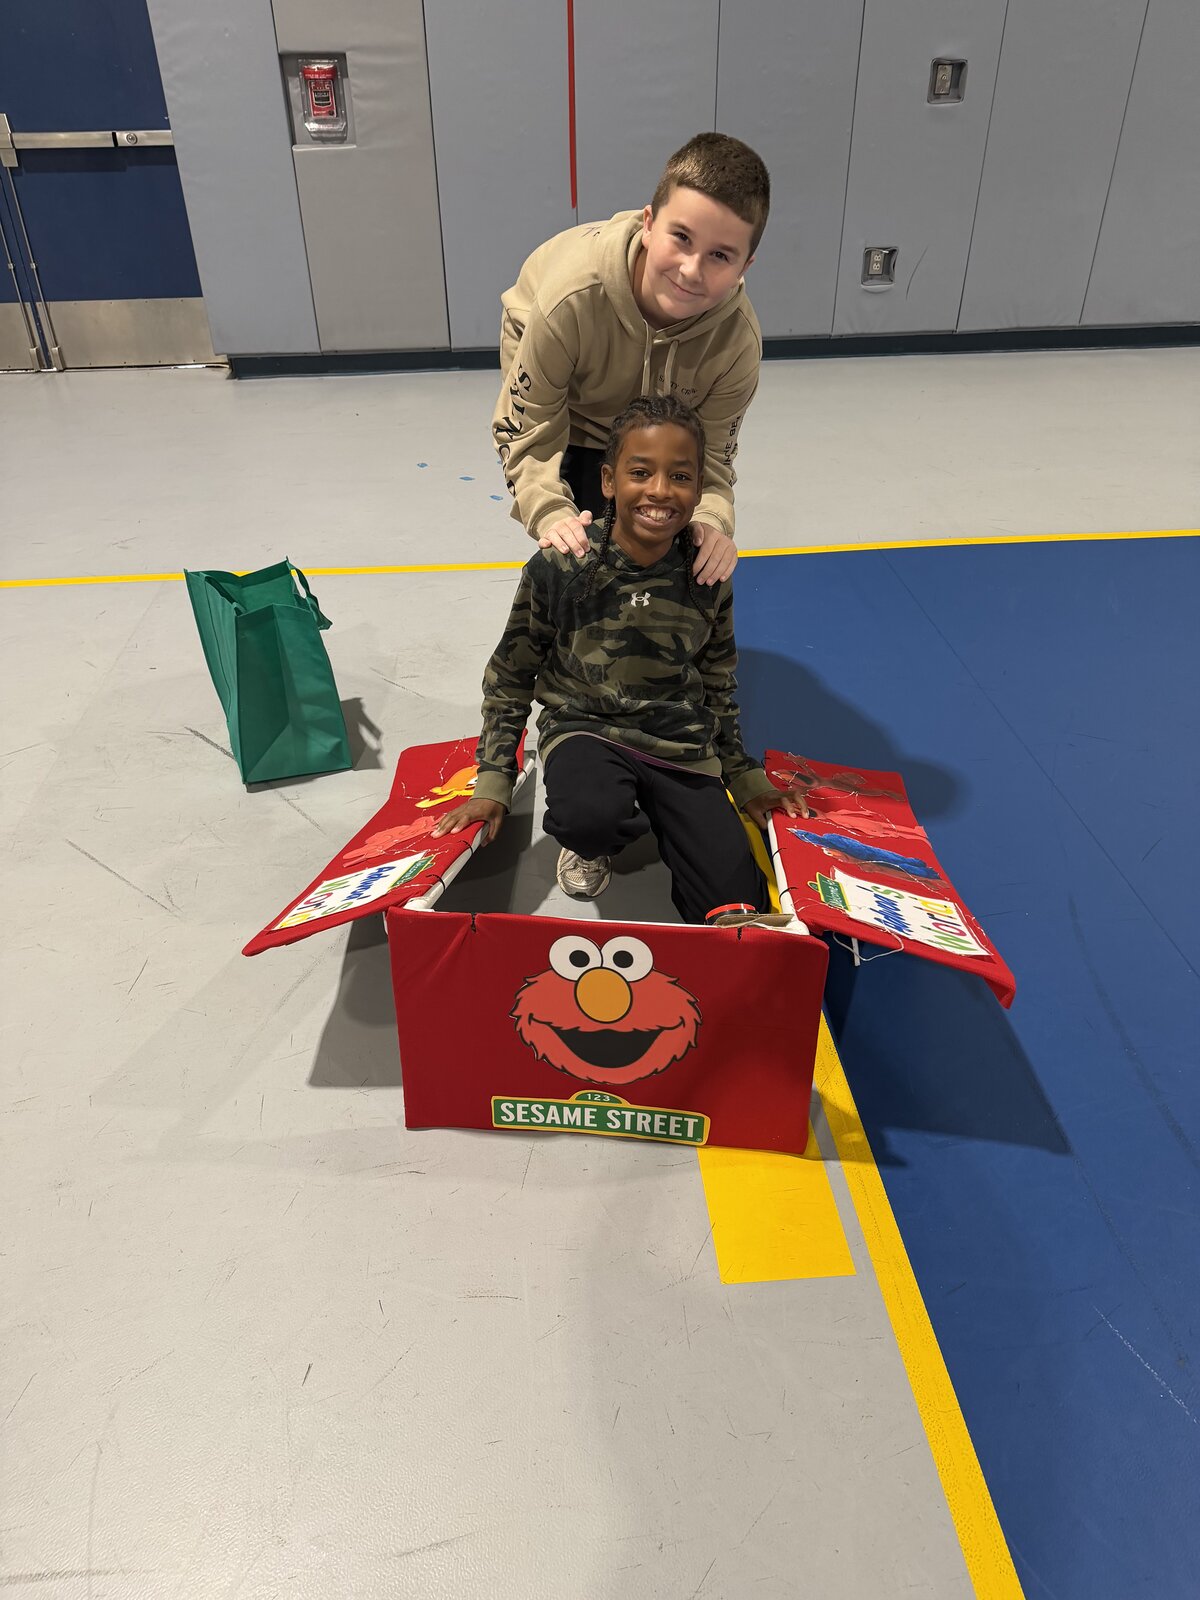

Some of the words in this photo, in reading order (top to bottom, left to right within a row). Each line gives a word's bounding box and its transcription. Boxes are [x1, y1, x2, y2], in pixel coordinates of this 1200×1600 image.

[908, 896, 979, 951] World
[500, 1102, 598, 1128] SESAME
[606, 1109, 699, 1139] STREET
